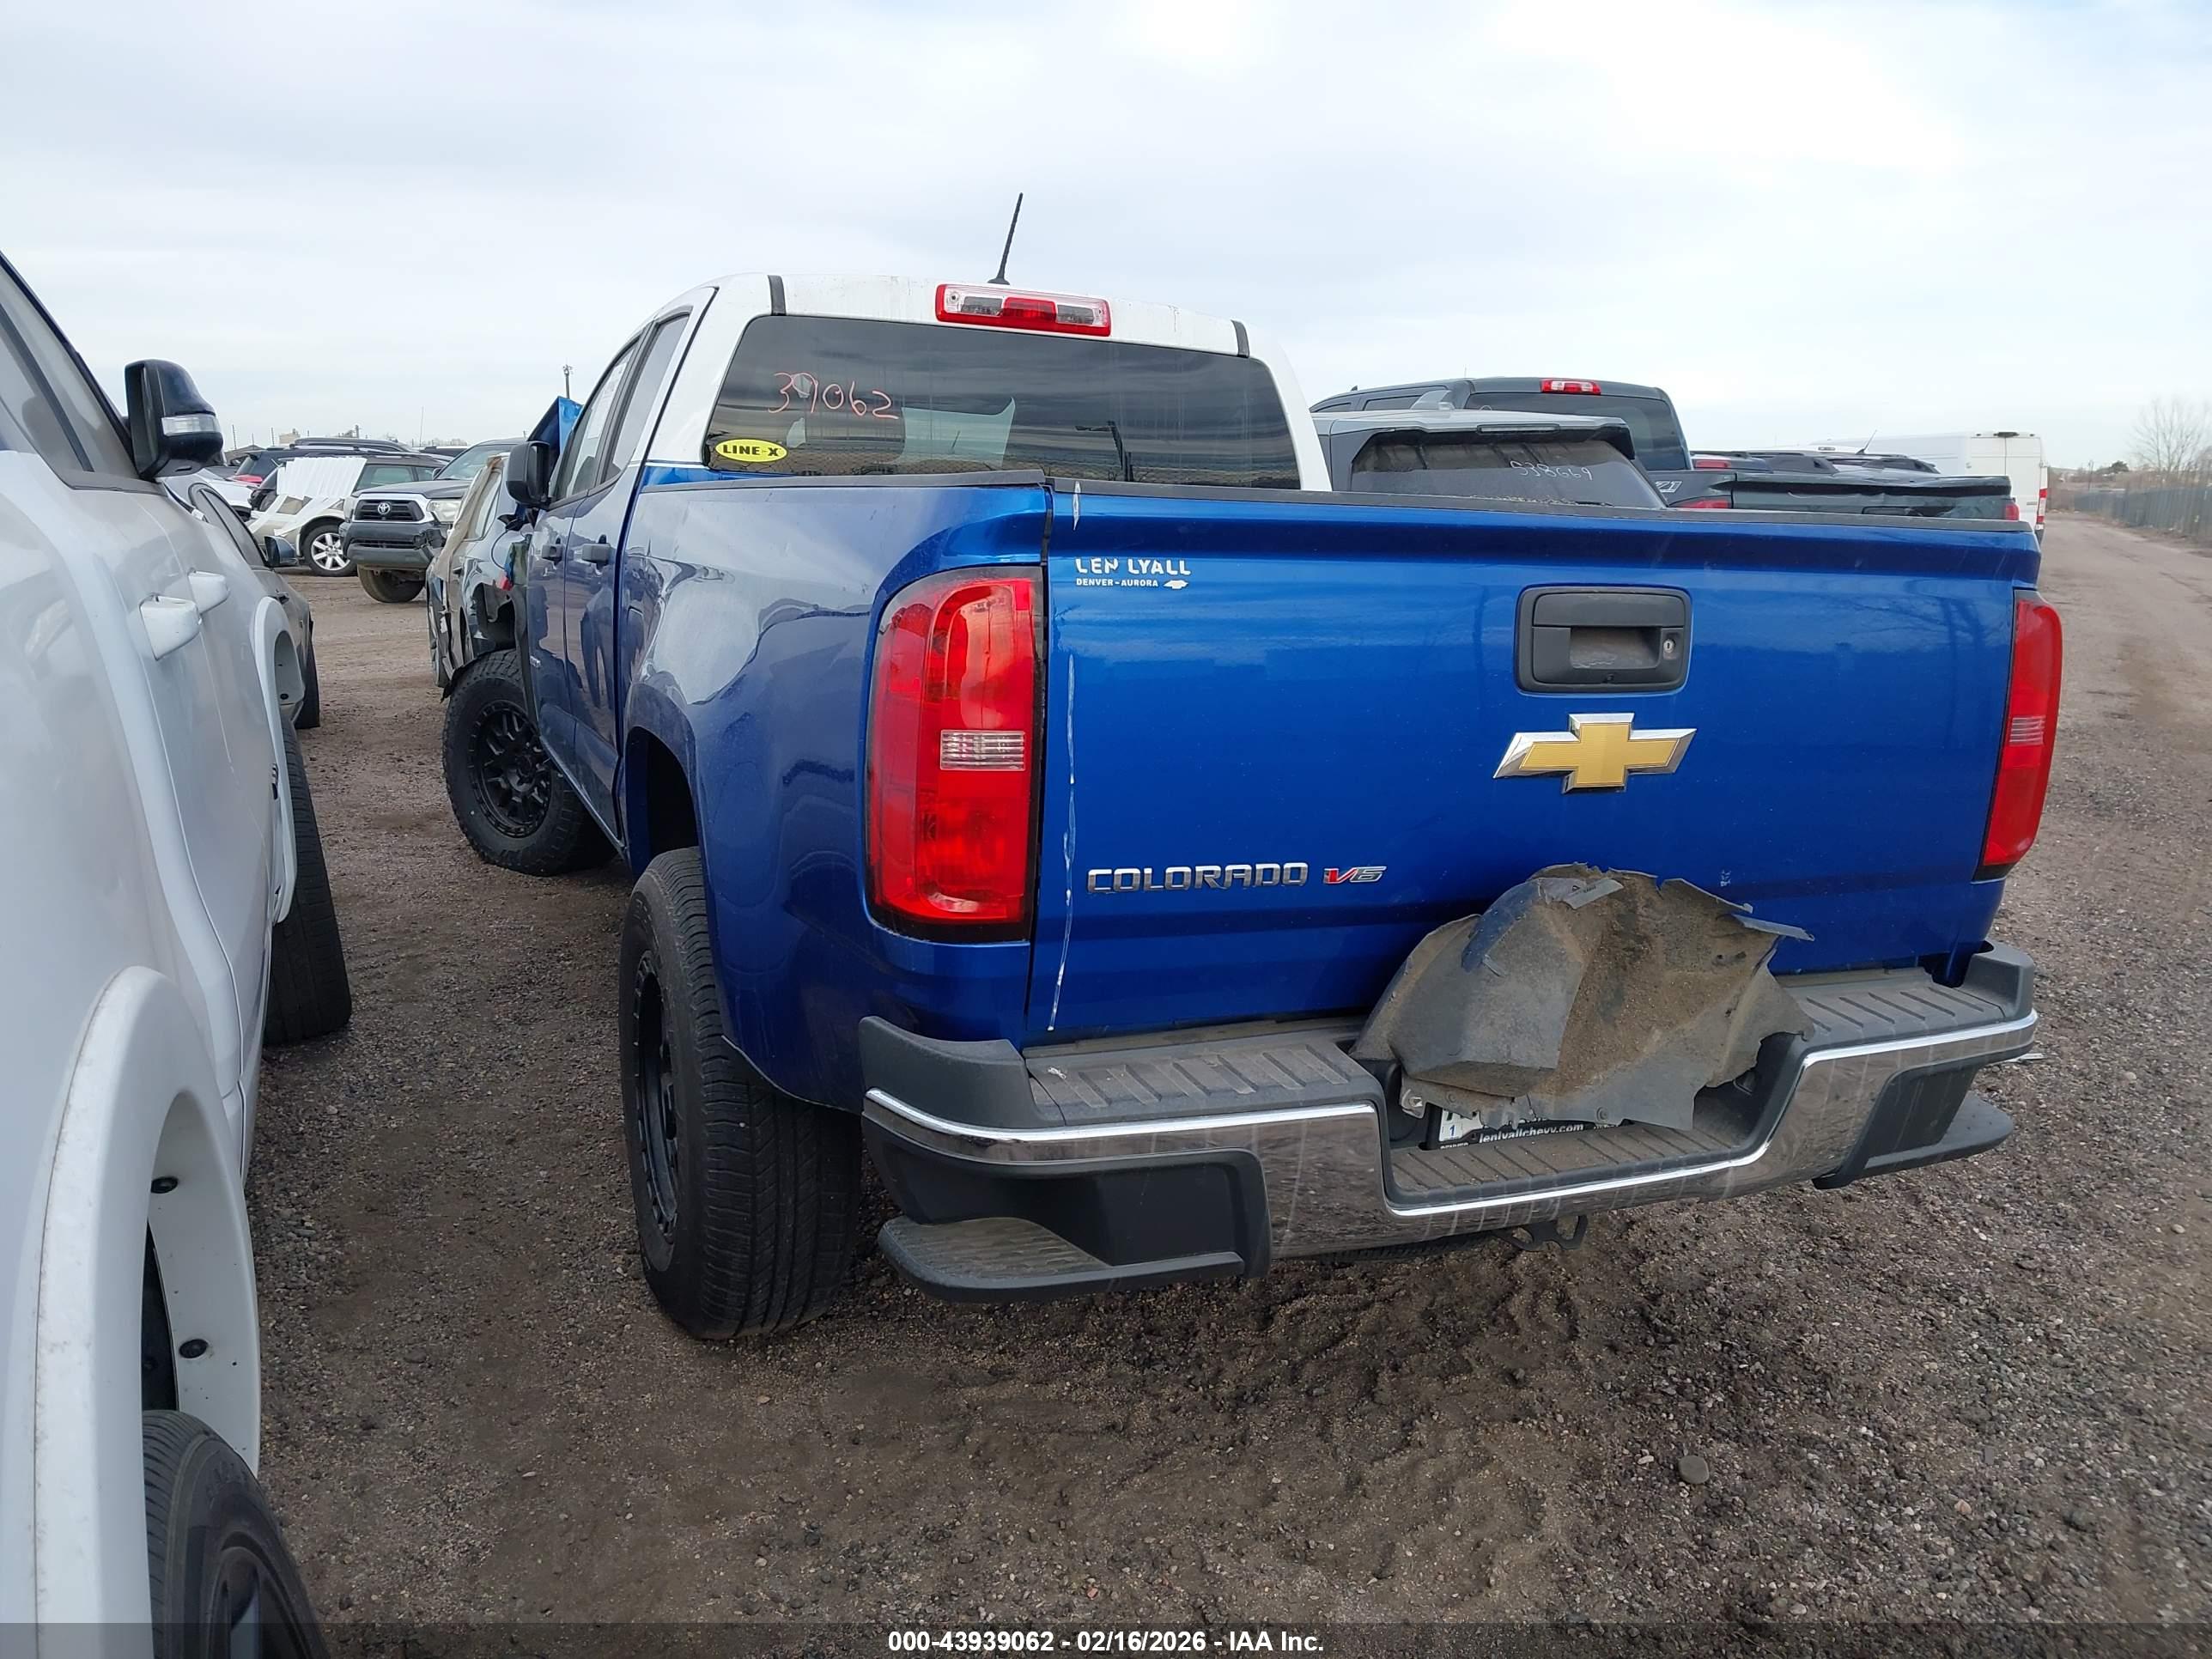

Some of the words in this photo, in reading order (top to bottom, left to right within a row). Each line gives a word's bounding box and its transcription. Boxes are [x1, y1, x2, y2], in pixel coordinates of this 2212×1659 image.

[768, 372, 900, 420] 39062
[1075, 558, 1119, 574] LEN
[1127, 558, 1192, 575] LYALL
[1088, 862, 1309, 894] COLORADO
[1323, 866, 1388, 884] V6
